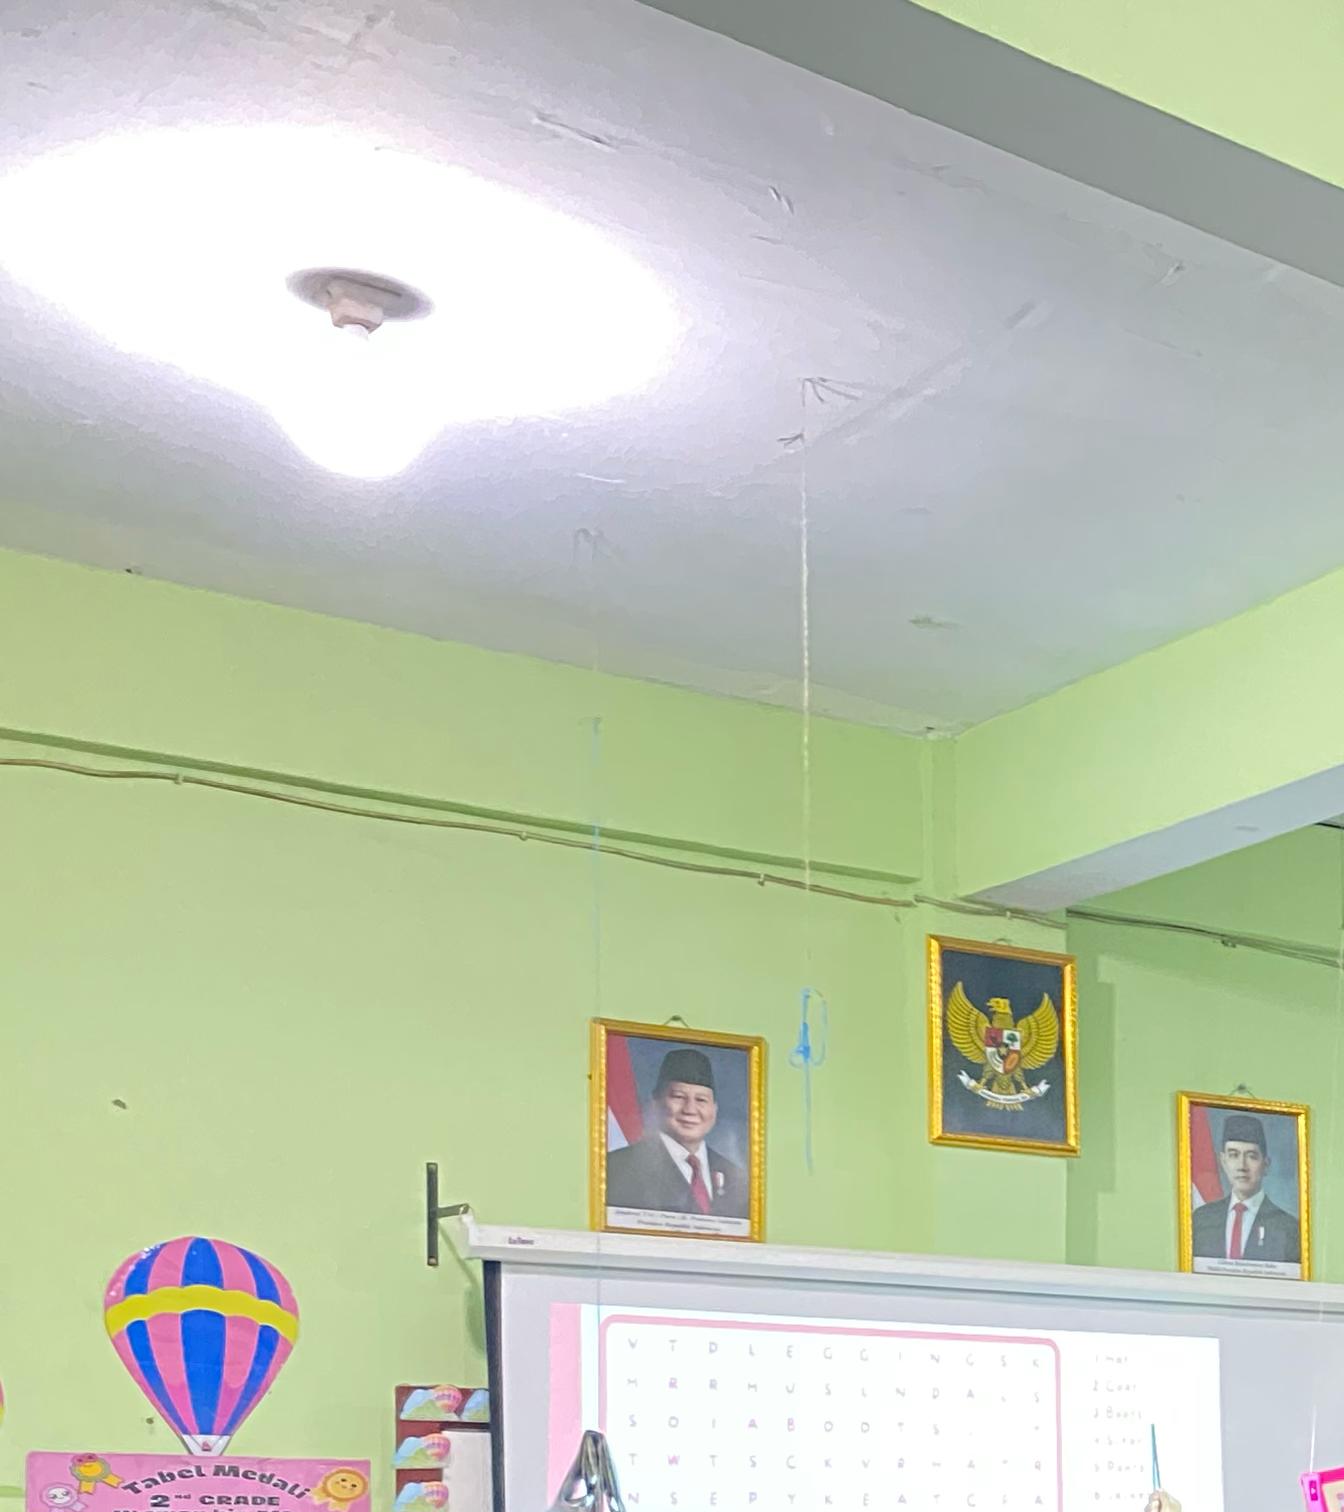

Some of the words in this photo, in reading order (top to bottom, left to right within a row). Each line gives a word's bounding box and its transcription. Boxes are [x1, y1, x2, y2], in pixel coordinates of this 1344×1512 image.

[121, 1464, 207, 1495] Tabel
[212, 1464, 311, 1499] Medali
[199, 1495, 281, 1507] GRADE
